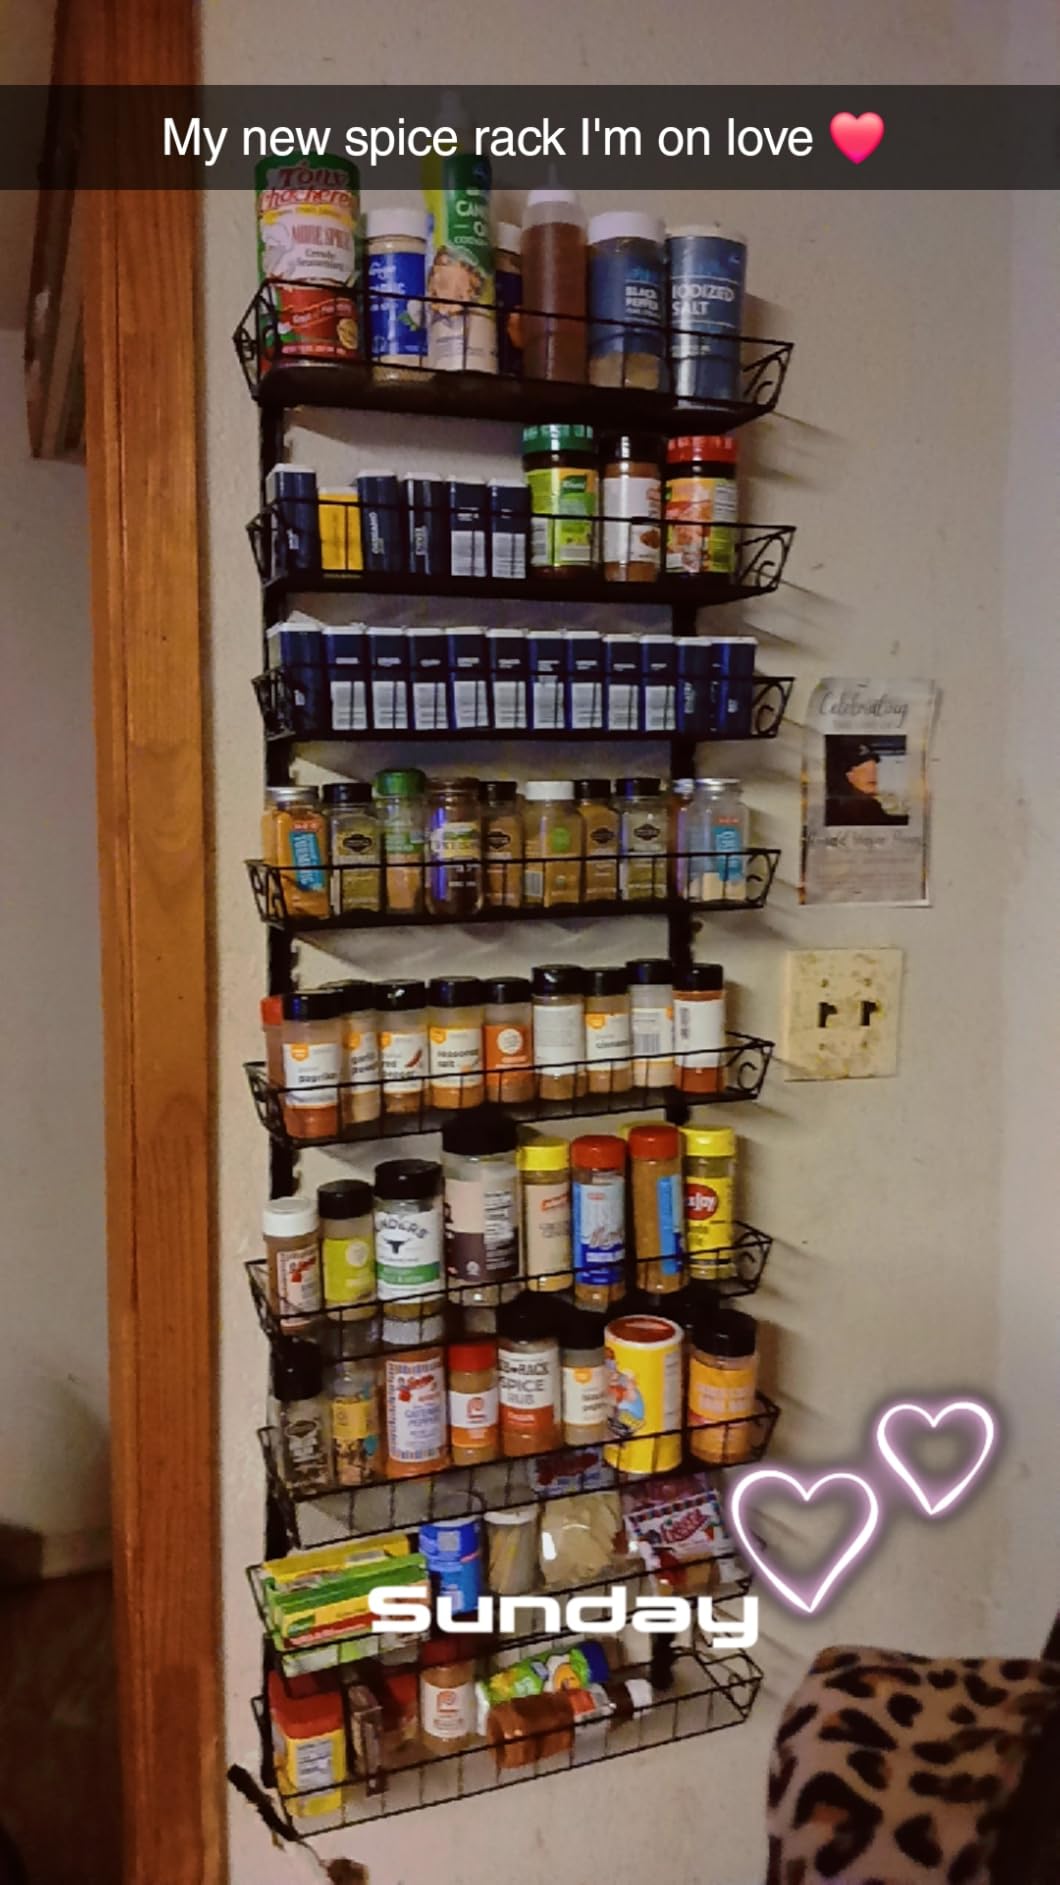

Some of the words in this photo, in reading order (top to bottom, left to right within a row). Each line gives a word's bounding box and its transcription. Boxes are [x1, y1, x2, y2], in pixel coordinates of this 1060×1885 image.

[671, 283, 736, 302] IODIZED
[671, 301, 710, 316] SALT
[819, 691, 910, 728] Celebrating
[501, 1377, 544, 1392] SPICE
